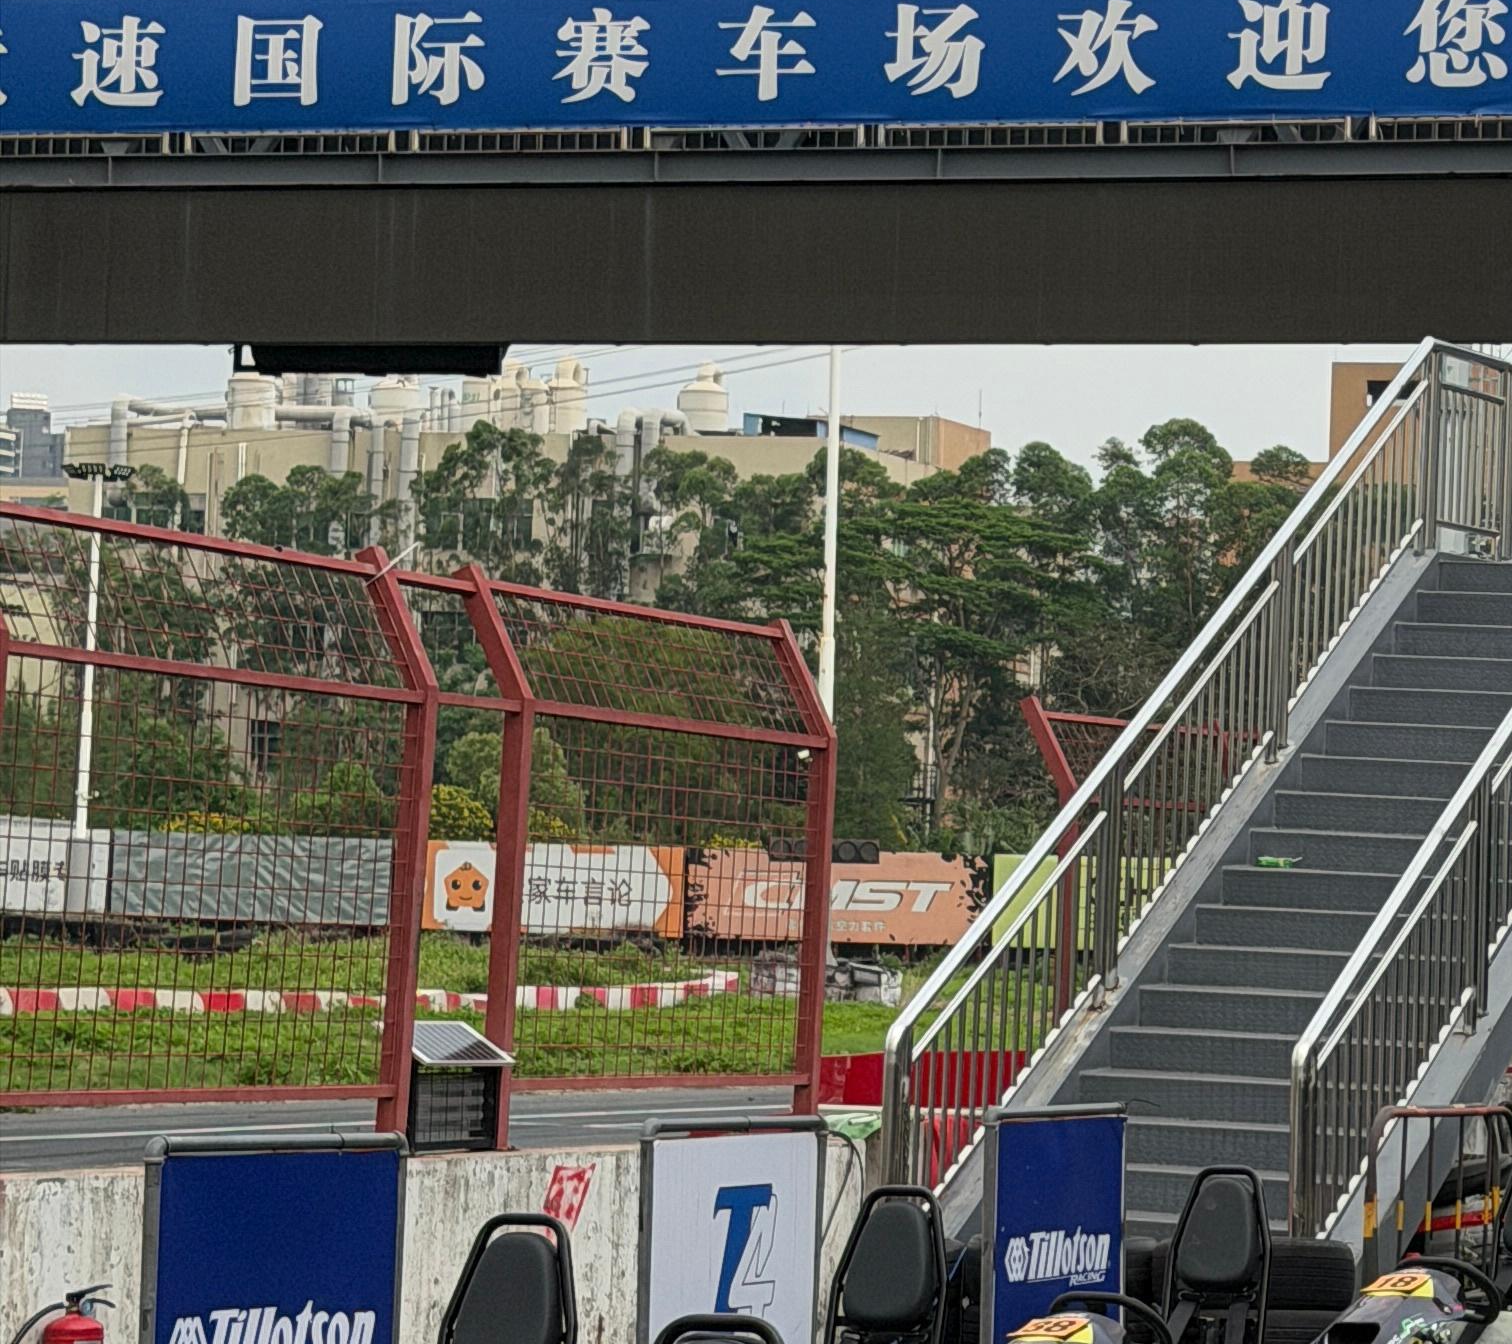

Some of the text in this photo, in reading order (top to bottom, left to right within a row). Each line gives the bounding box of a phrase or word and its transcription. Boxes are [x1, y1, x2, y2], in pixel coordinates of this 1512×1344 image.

[520, 875, 633, 908] 家车言论
[1027, 1225, 1111, 1280] Tillotson
[1069, 1270, 1106, 1287] RACING
[1377, 1276, 1418, 1289] 18
[1022, 1320, 1077, 1333] 38
